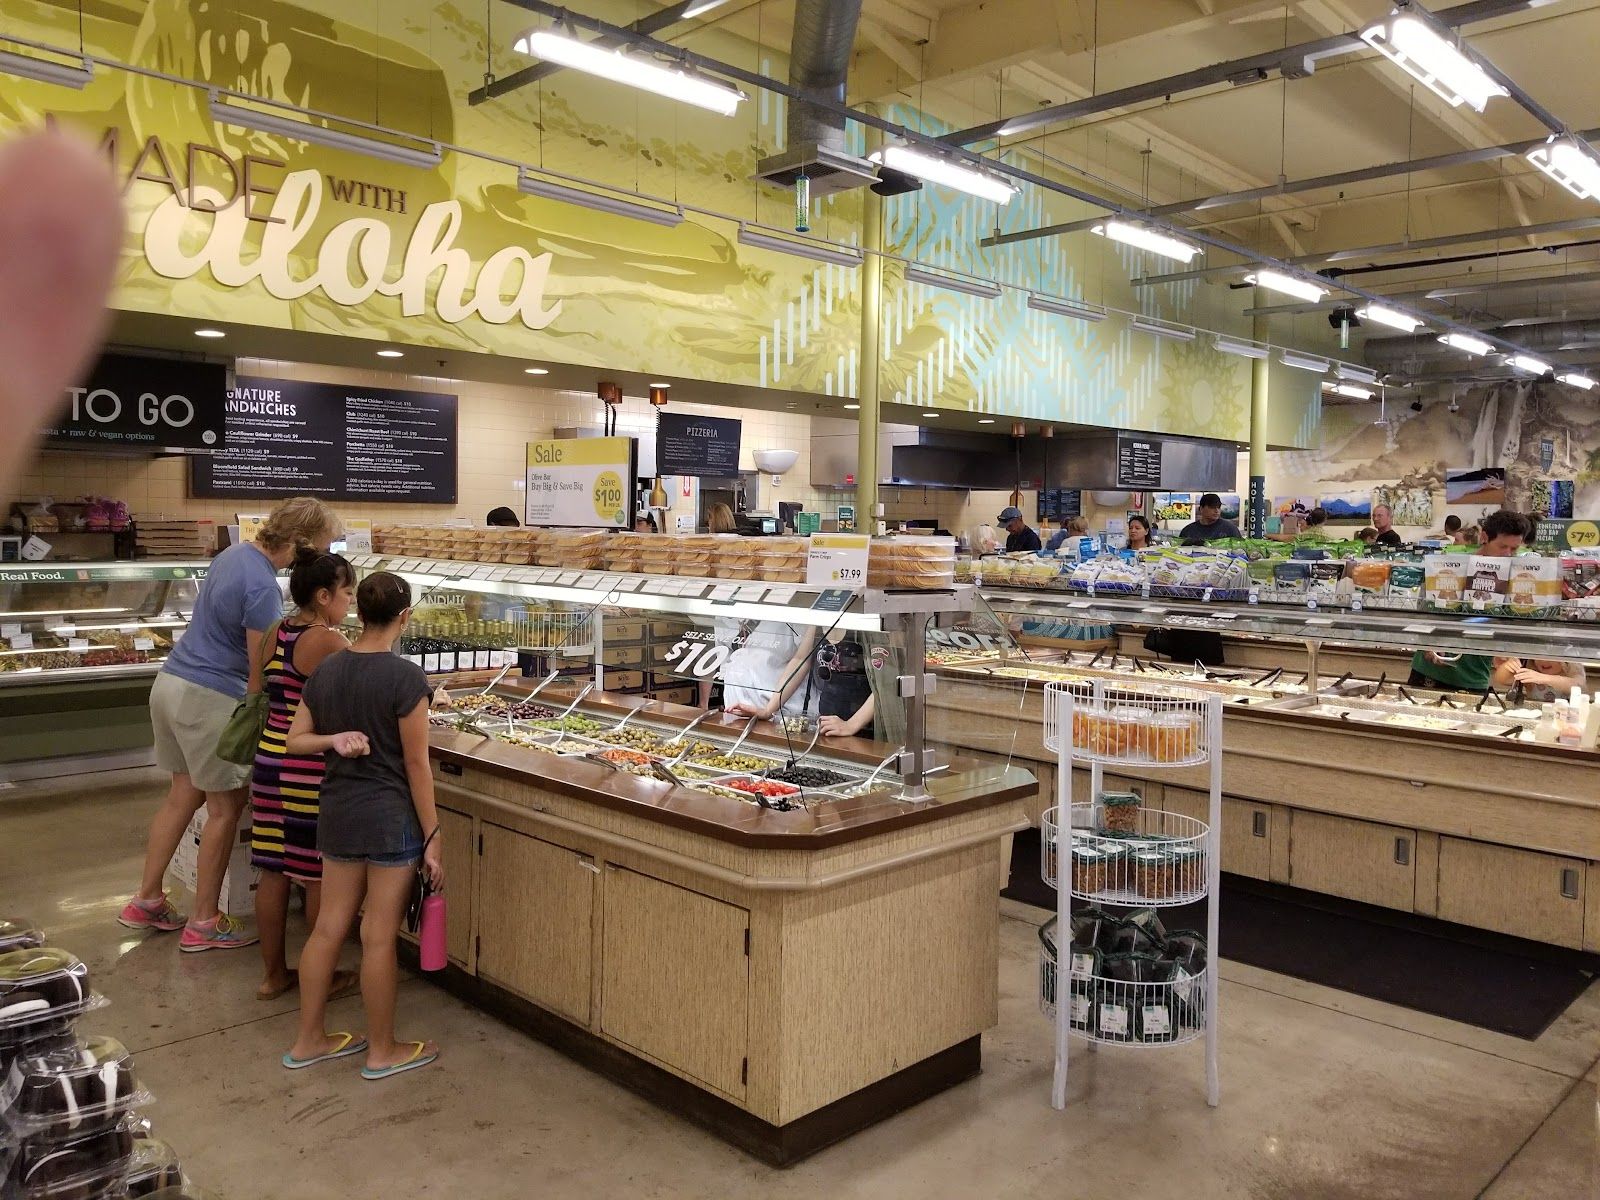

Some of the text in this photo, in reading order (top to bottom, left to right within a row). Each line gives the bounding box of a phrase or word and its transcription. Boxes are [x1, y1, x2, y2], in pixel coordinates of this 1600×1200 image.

[327, 174, 408, 215] WITH
[144, 168, 562, 330] aloha
[226, 387, 281, 403] GNATURE
[64, 386, 195, 428] TO GO
[225, 400, 297, 417] NDWICHES
[88, 429, 97, 437] &
[99, 431, 123, 440] vegan
[125, 431, 155, 441] options
[686, 427, 718, 438] PIZZERIA
[535, 445, 562, 464] Sale
[531, 473, 551, 481] Olive Bar
[600, 477, 616, 487] Save
[531, 481, 584, 493] Buy Big & Save Big
[1536, 522, 1565, 530] EDNESDAY
[812, 538, 825, 546] Sale
[1, 571, 65, 581] Real Food.
[840, 568, 861, 579] $7.99
[682, 631, 704, 640] SELF
